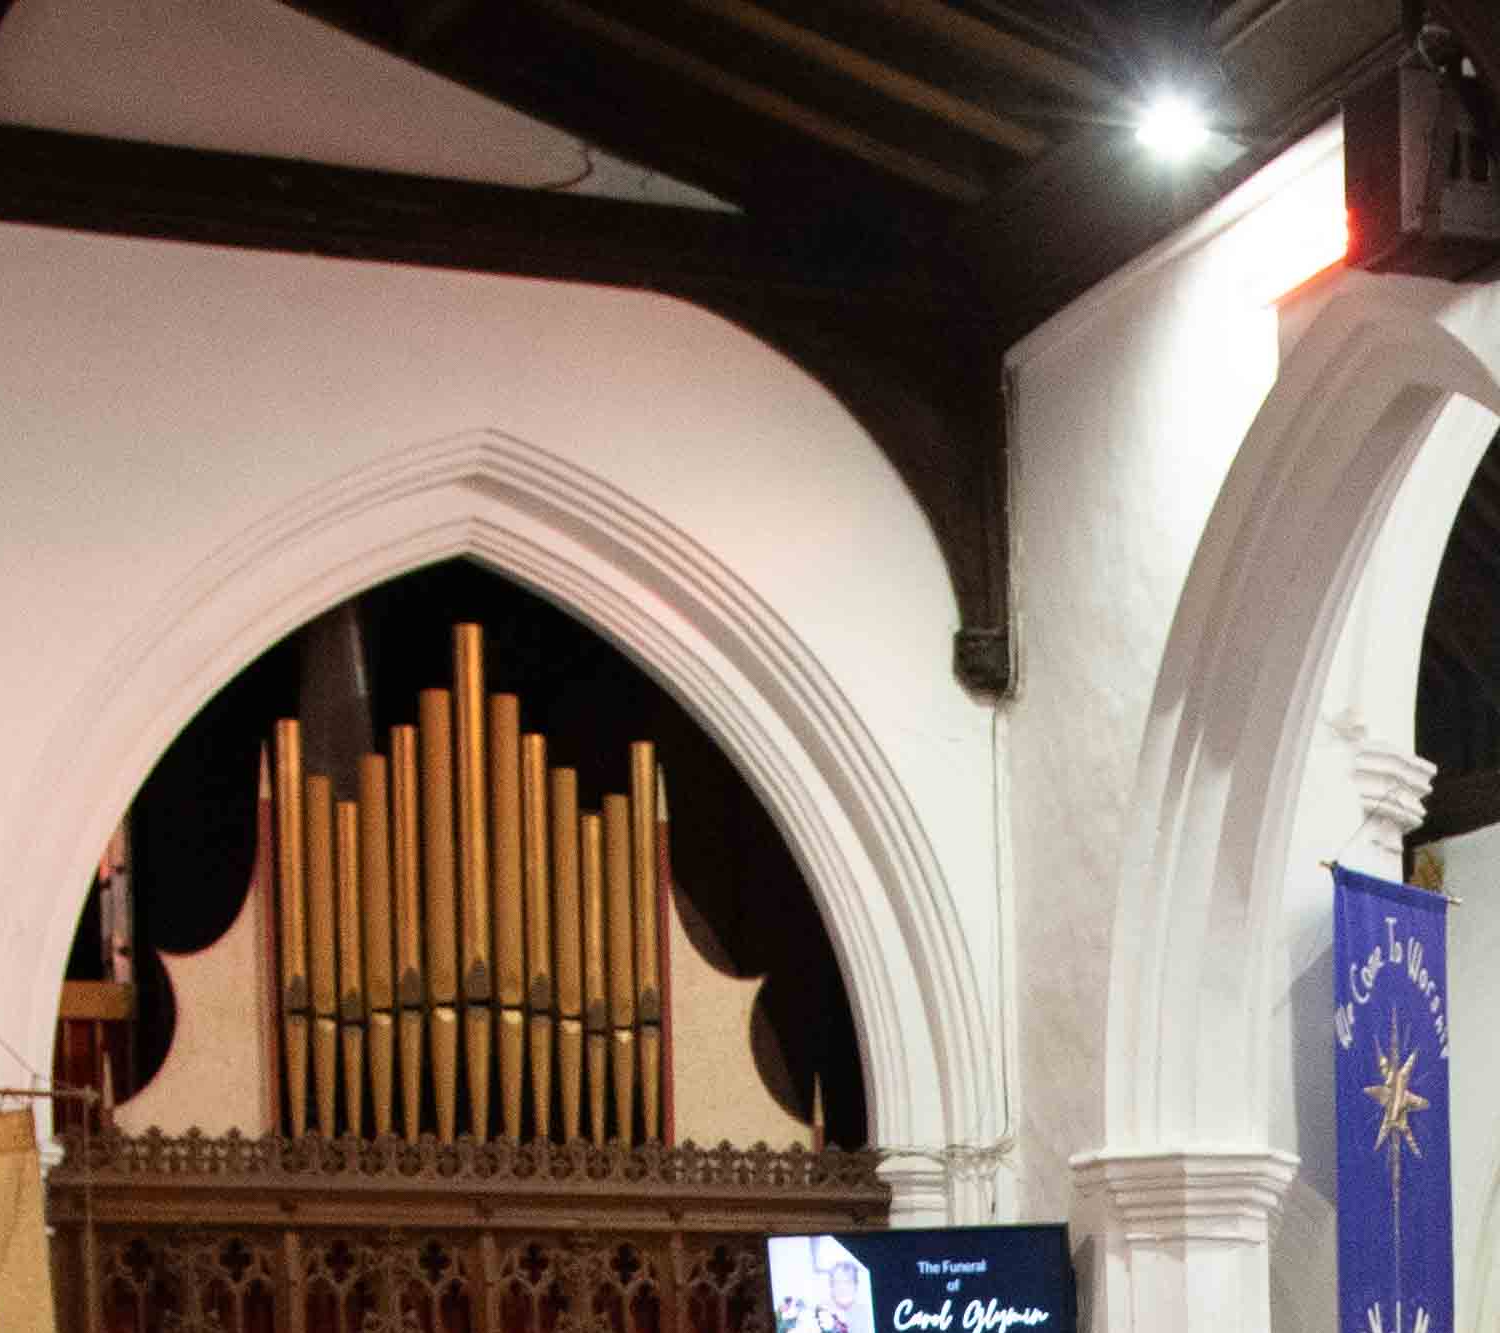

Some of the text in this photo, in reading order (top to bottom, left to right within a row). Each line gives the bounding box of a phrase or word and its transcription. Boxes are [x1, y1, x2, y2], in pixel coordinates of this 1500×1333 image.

[1385, 916, 1403, 964] To
[916, 1258, 988, 1275] The Funeral
[946, 1278, 960, 1292] of
[892, 1298, 953, 1332] Carol
